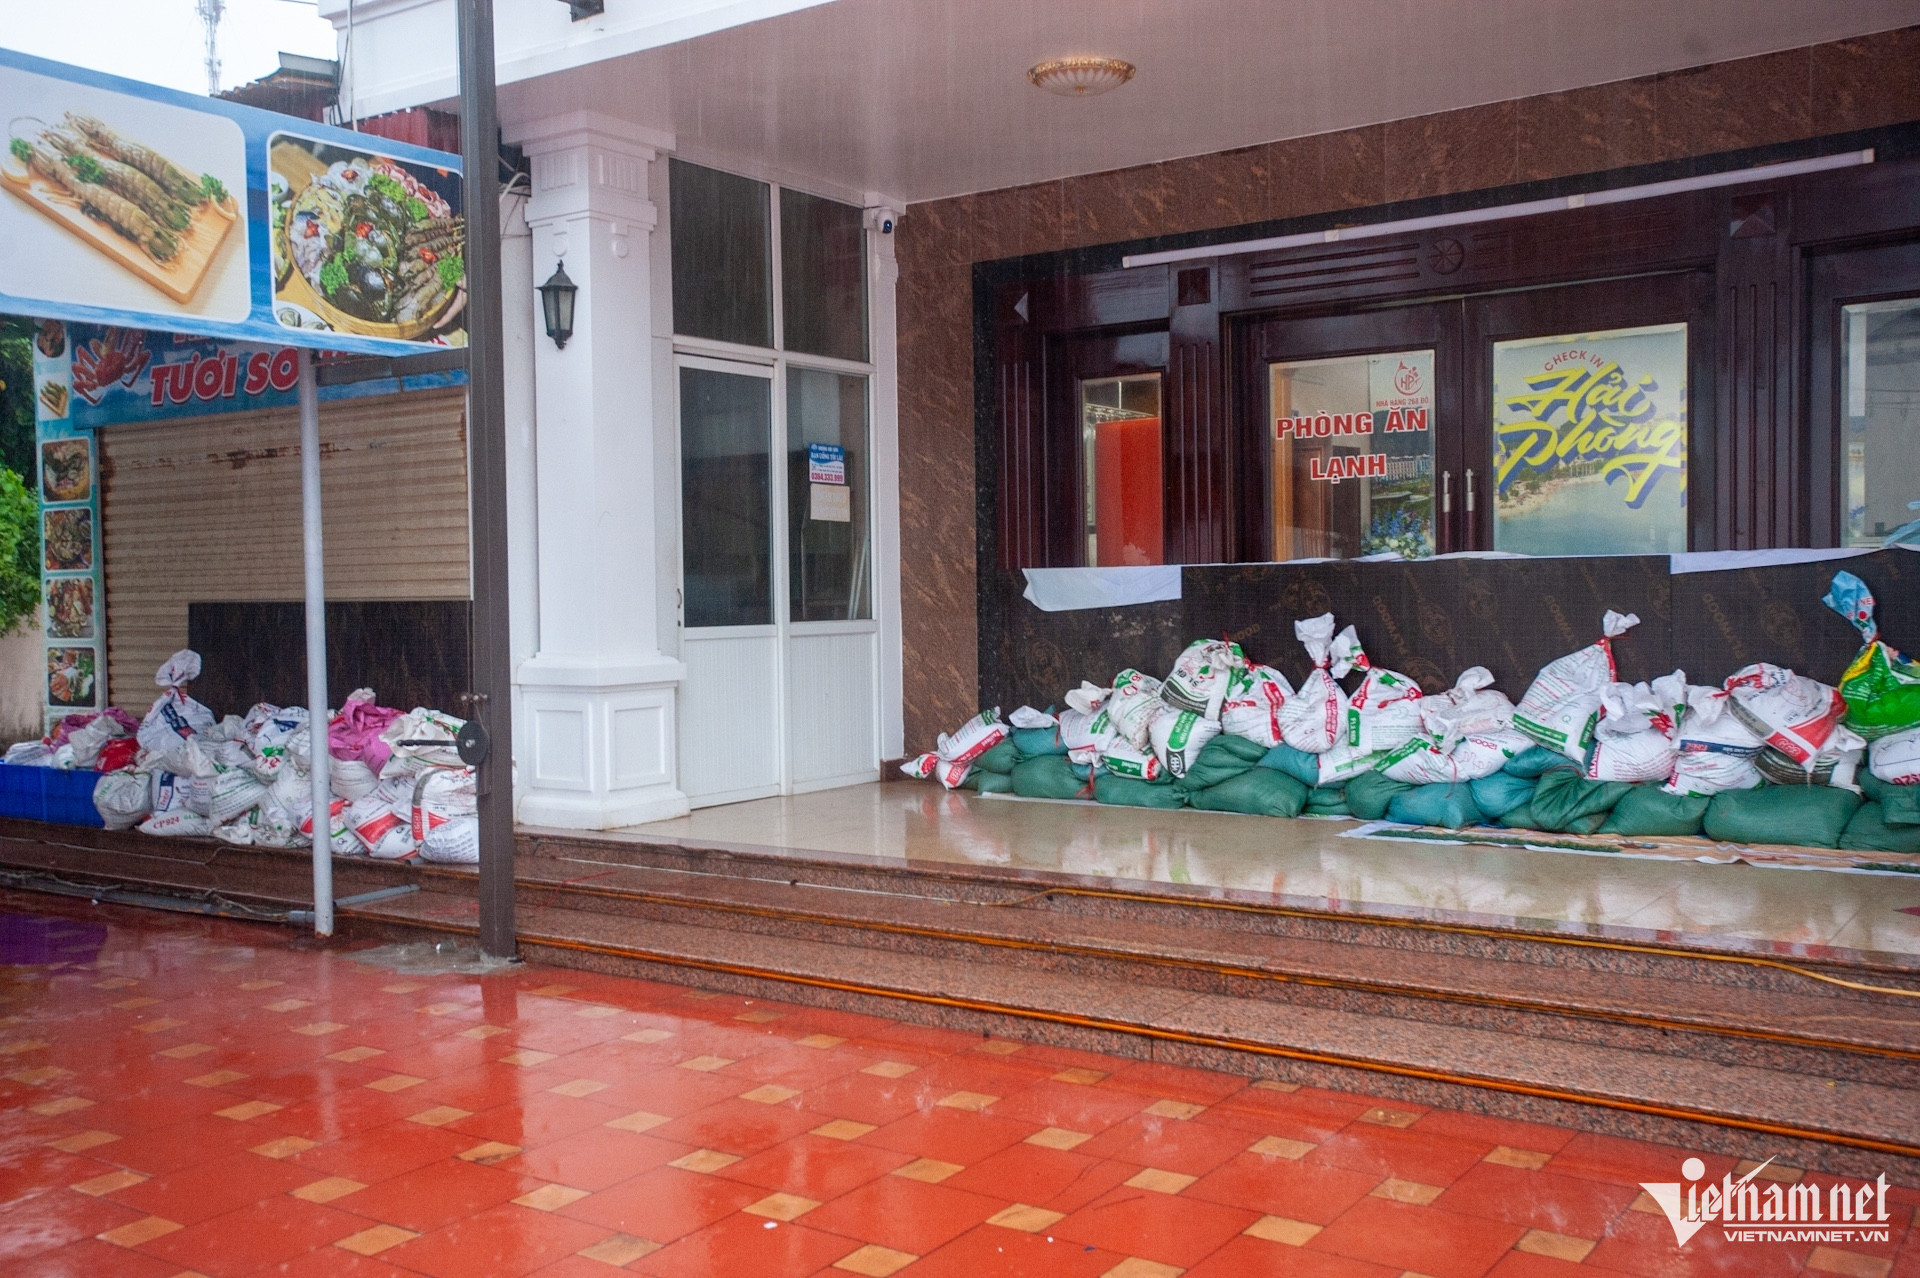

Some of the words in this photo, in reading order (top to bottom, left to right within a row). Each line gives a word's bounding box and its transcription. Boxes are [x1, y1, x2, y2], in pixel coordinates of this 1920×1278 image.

[1544, 350, 1587, 371] CHECK
[1590, 354, 1604, 368] IN
[151, 350, 238, 405] TƯƠI
[1276, 411, 1373, 440] PHÒNG
[1384, 406, 1428, 433] ĂN
[1310, 454, 1387, 484] LẠNH
